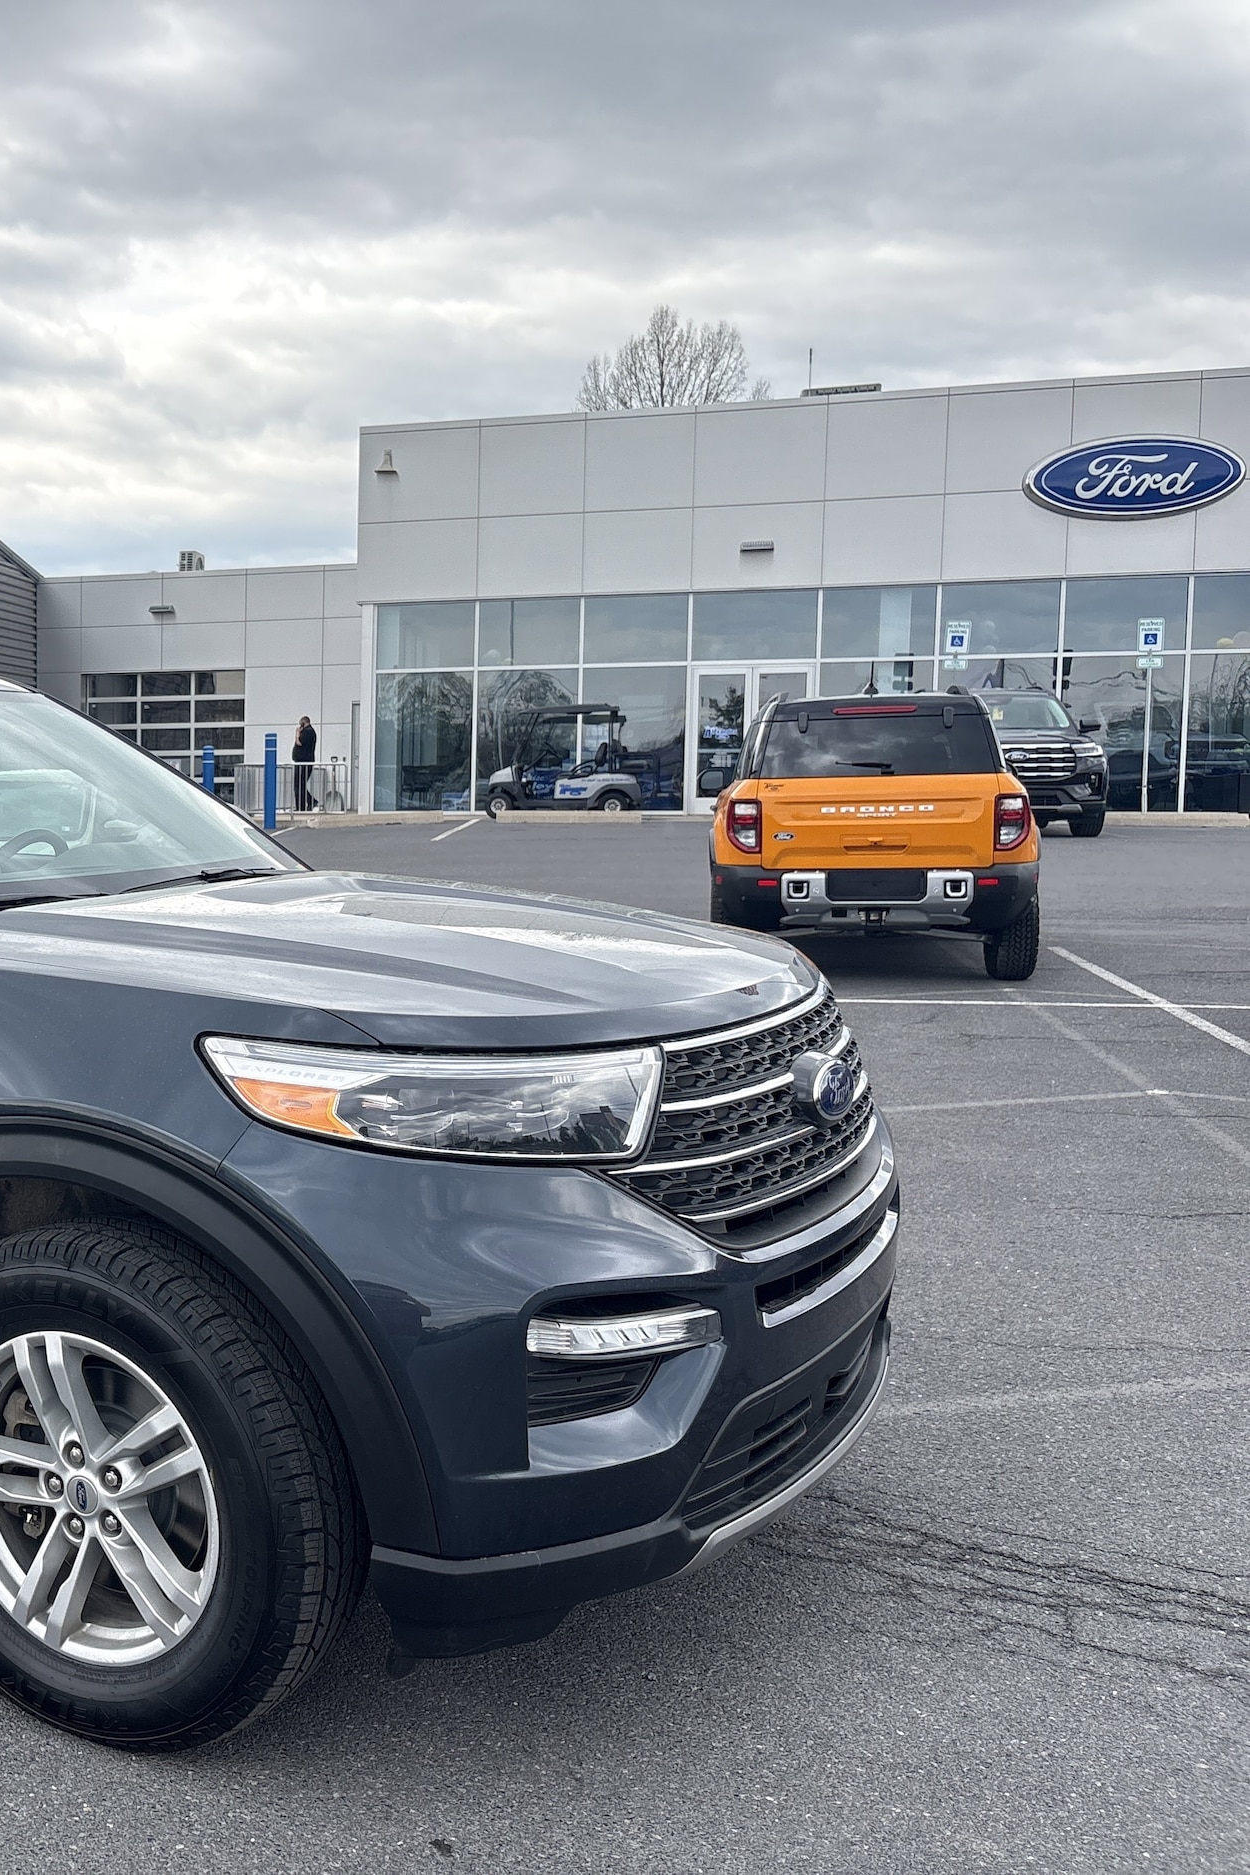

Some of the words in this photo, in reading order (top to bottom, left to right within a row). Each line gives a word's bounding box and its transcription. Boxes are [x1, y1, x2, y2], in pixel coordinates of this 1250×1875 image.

[1075, 453, 1198, 499] Ford
[820, 804, 934, 814] BRONCO
[238, 1064, 346, 1083] EXPLORER
[5, 1279, 133, 1324] KELLY
